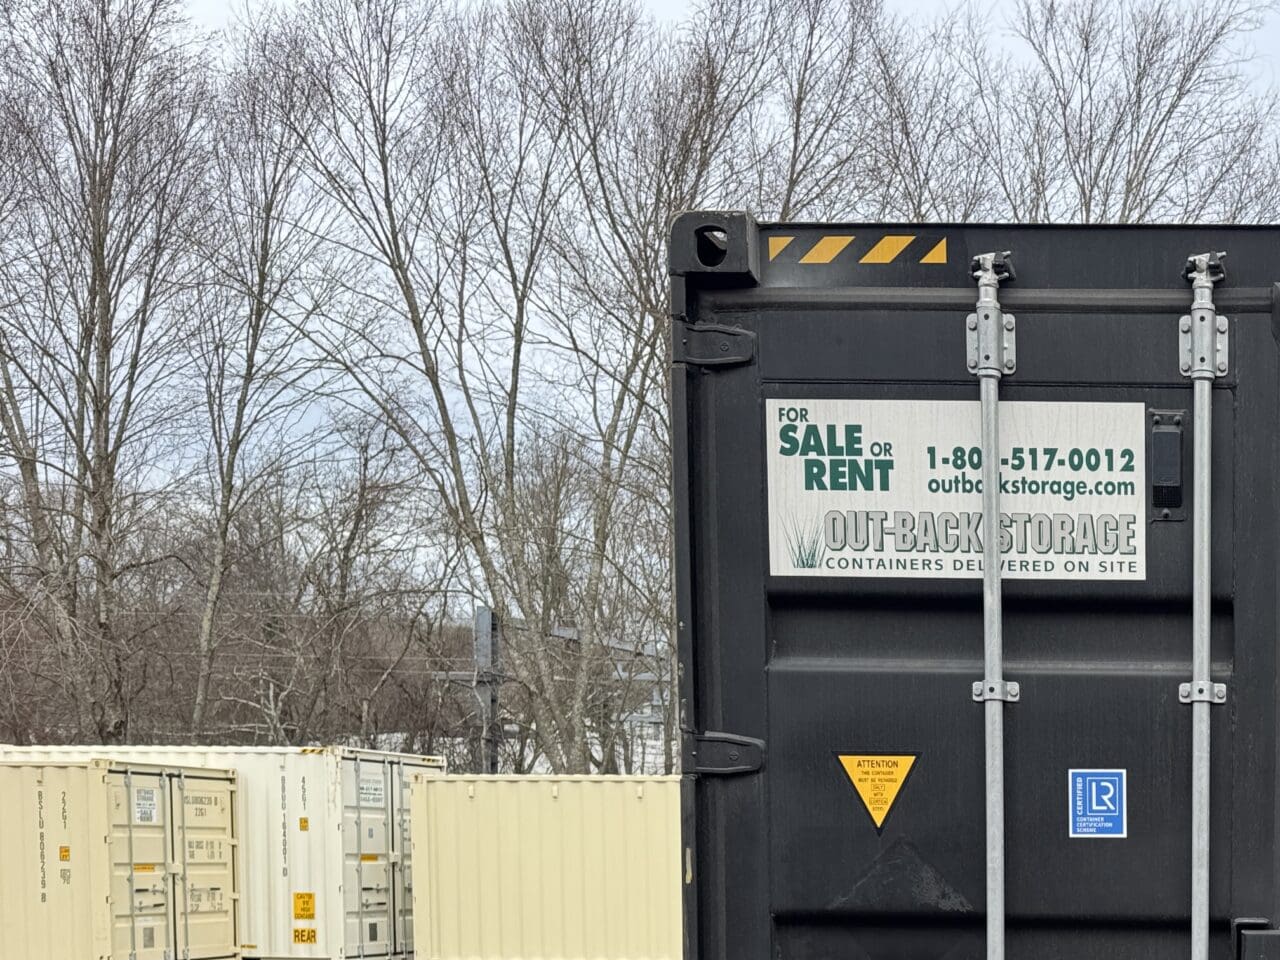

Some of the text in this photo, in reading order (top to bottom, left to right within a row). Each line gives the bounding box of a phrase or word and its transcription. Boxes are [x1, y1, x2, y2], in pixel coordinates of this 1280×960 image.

[778, 407, 809, 423] FOR
[778, 423, 893, 458] SALE OR
[927, 446, 1135, 472] 1-80-517-0012
[804, 458, 894, 491] RENT
[928, 471, 1136, 501] outbakstorage.com
[999, 510, 1137, 555] STORAGE
[826, 556, 1138, 573] CONTAINERS DELERED ON SITE
[857, 760, 898, 768] ATTENTION
[294, 929, 316, 943] REAR
